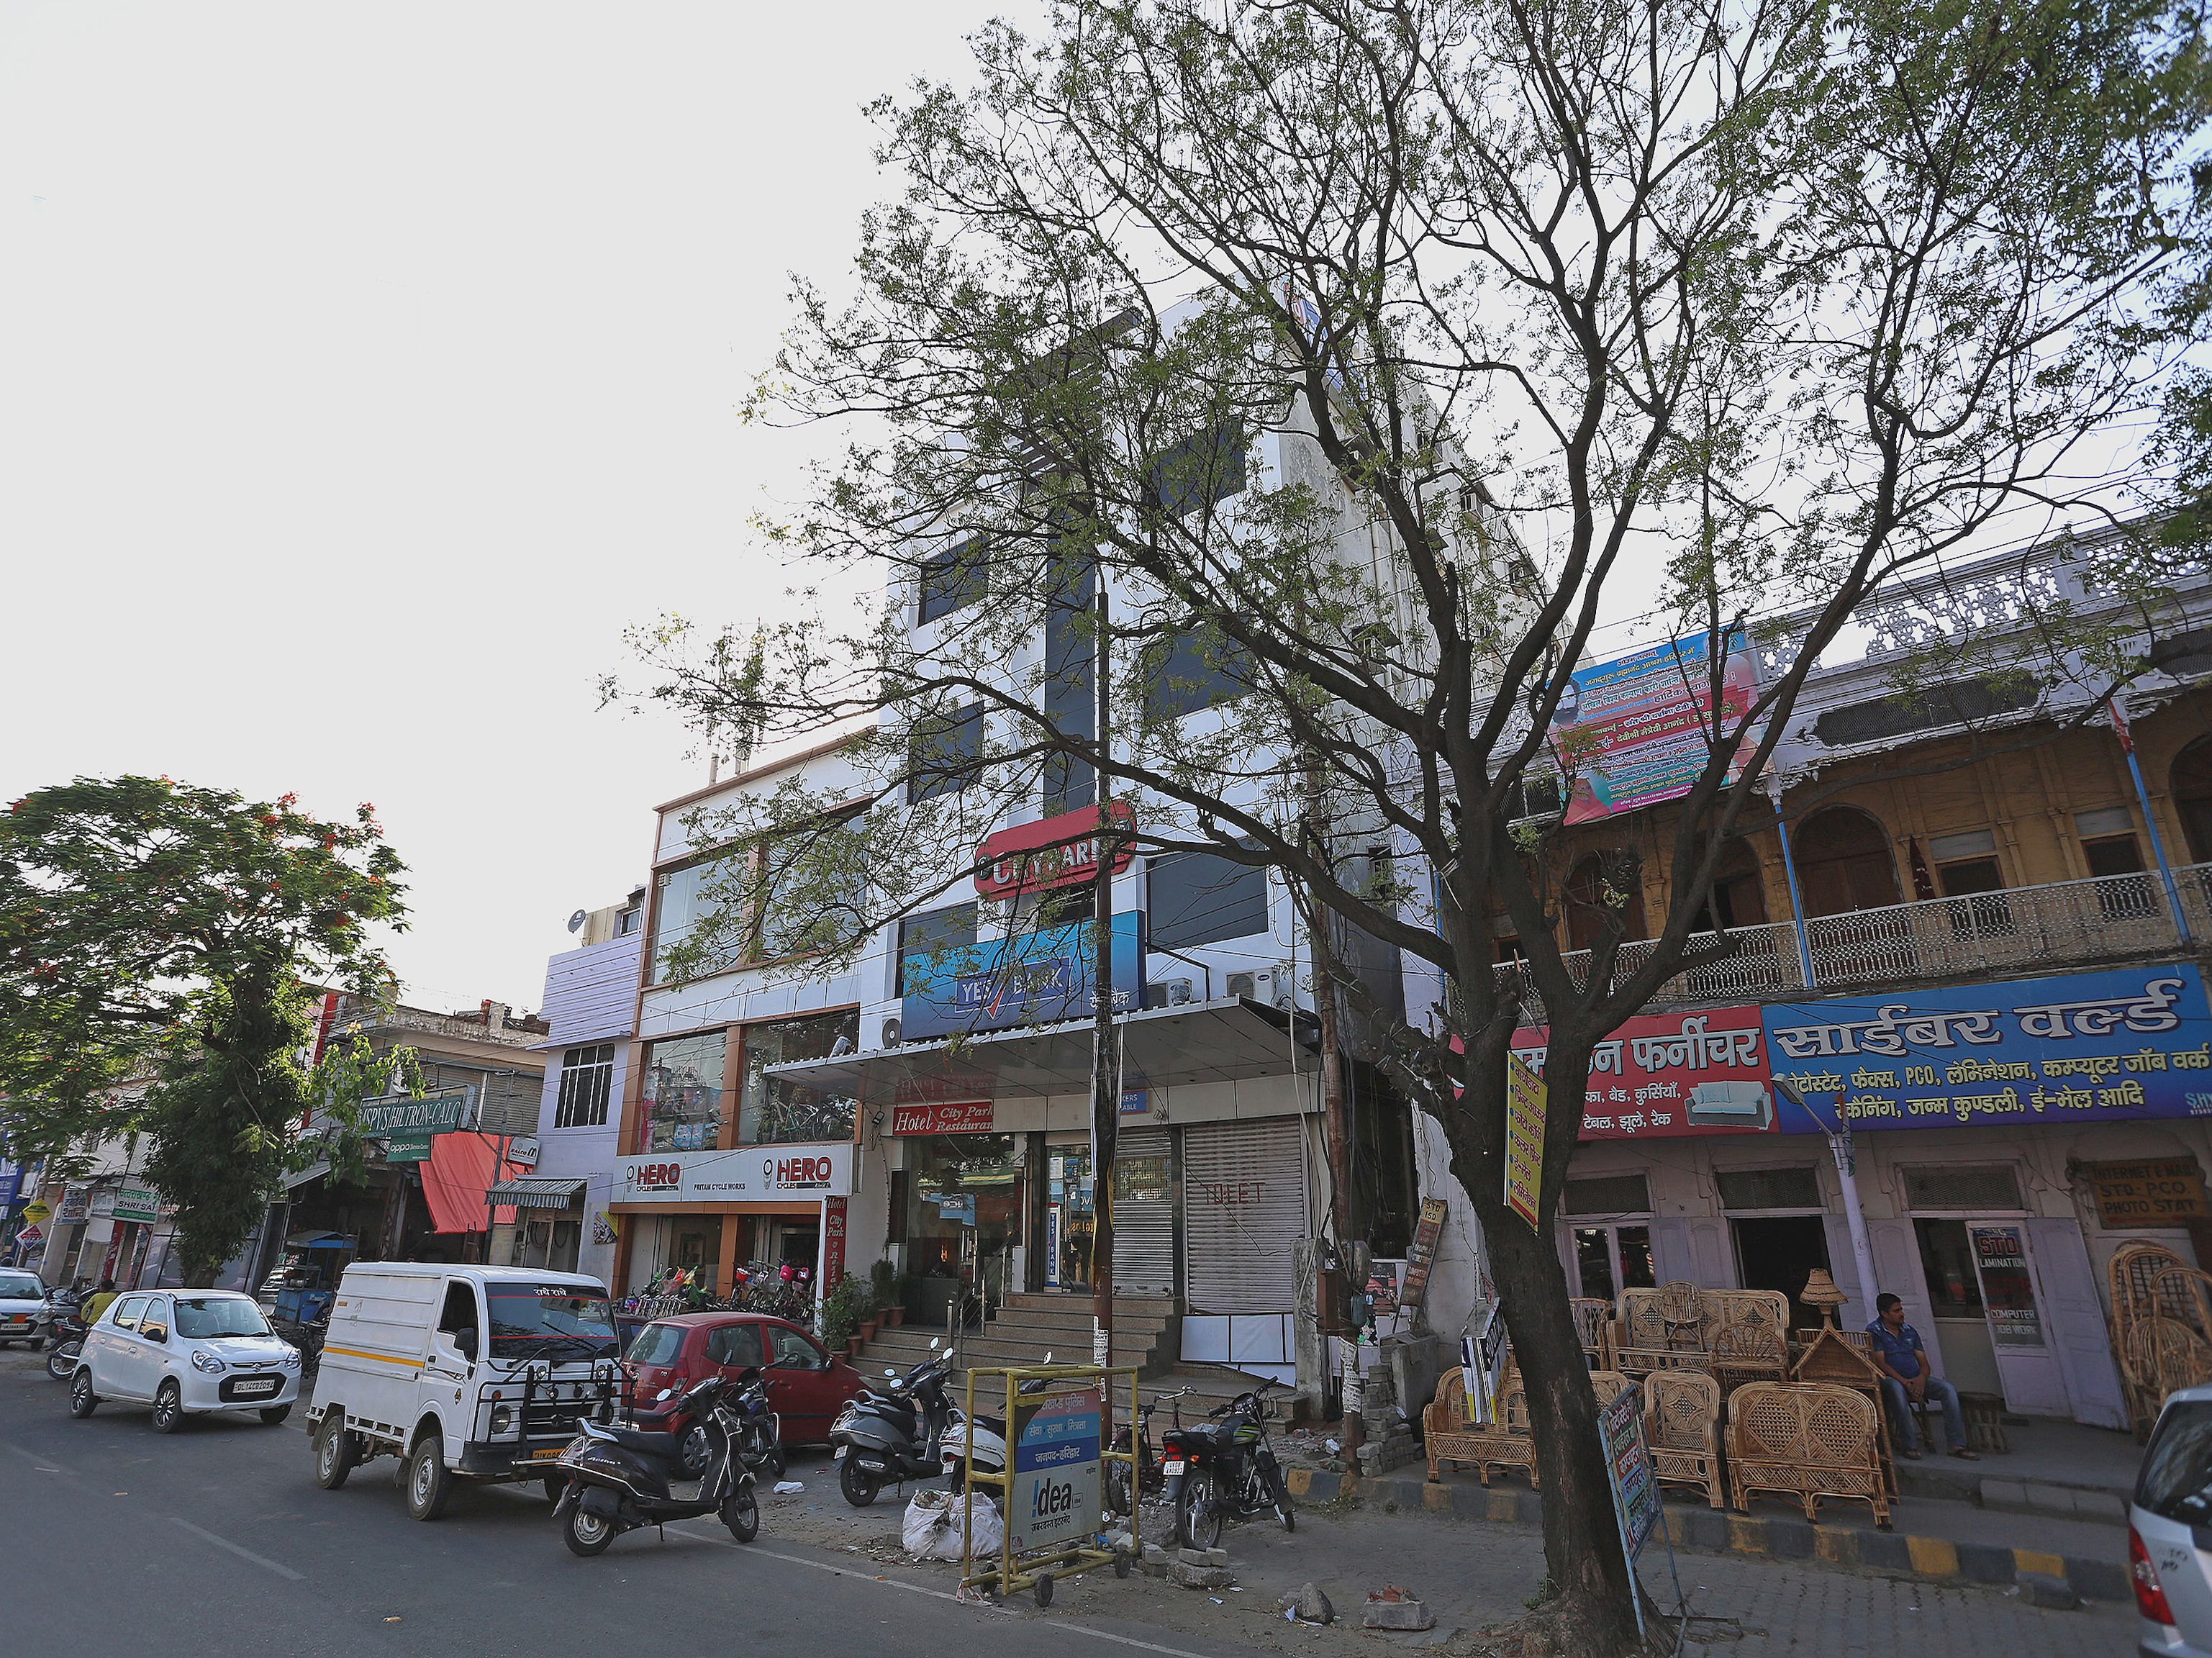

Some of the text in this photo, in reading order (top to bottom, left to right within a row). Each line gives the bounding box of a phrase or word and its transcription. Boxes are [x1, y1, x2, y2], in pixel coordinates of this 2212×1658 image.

[1772, 978, 2186, 1059] साईबर वर्ल्ड
[1631, 1015, 1761, 1074] फर्नीचर
[2040, 1055, 2121, 1085] कम्प्यूटर
[2121, 1047, 2167, 1073] जॉब
[2170, 1041, 2211, 1070] वर्क
[1905, 1097, 1949, 1116] जन्म
[2096, 1079, 2145, 1107] आदि
[940, 1107, 963, 1120] City
[1649, 1108, 1672, 1127] रैक
[894, 1110, 934, 1132] Hotel
[636, 1163, 681, 1185] HERO
[776, 1156, 833, 1182] HERO
[117, 1200, 140, 1210] SHRI
[140, 1202, 156, 1212] SAI
[1425, 1202, 1441, 1213] STD
[2103, 1199, 2196, 1214] PHOTO STAT
[829, 1214, 843, 1228] City
[1425, 1211, 1437, 1220] ISD
[827, 1227, 844, 1238] Park
[1978, 1235, 2019, 1256] STD
[1978, 1256, 2026, 1268] LAMINATION
[533, 1287, 567, 1297] राधे राधे
[1990, 1308, 2036, 1320] COMPUTER
[1995, 1324, 2038, 1336] JOB WORK
[1065, 1392, 1085, 1413] पुलिस
[1028, 1423, 1043, 1437] सेवा
